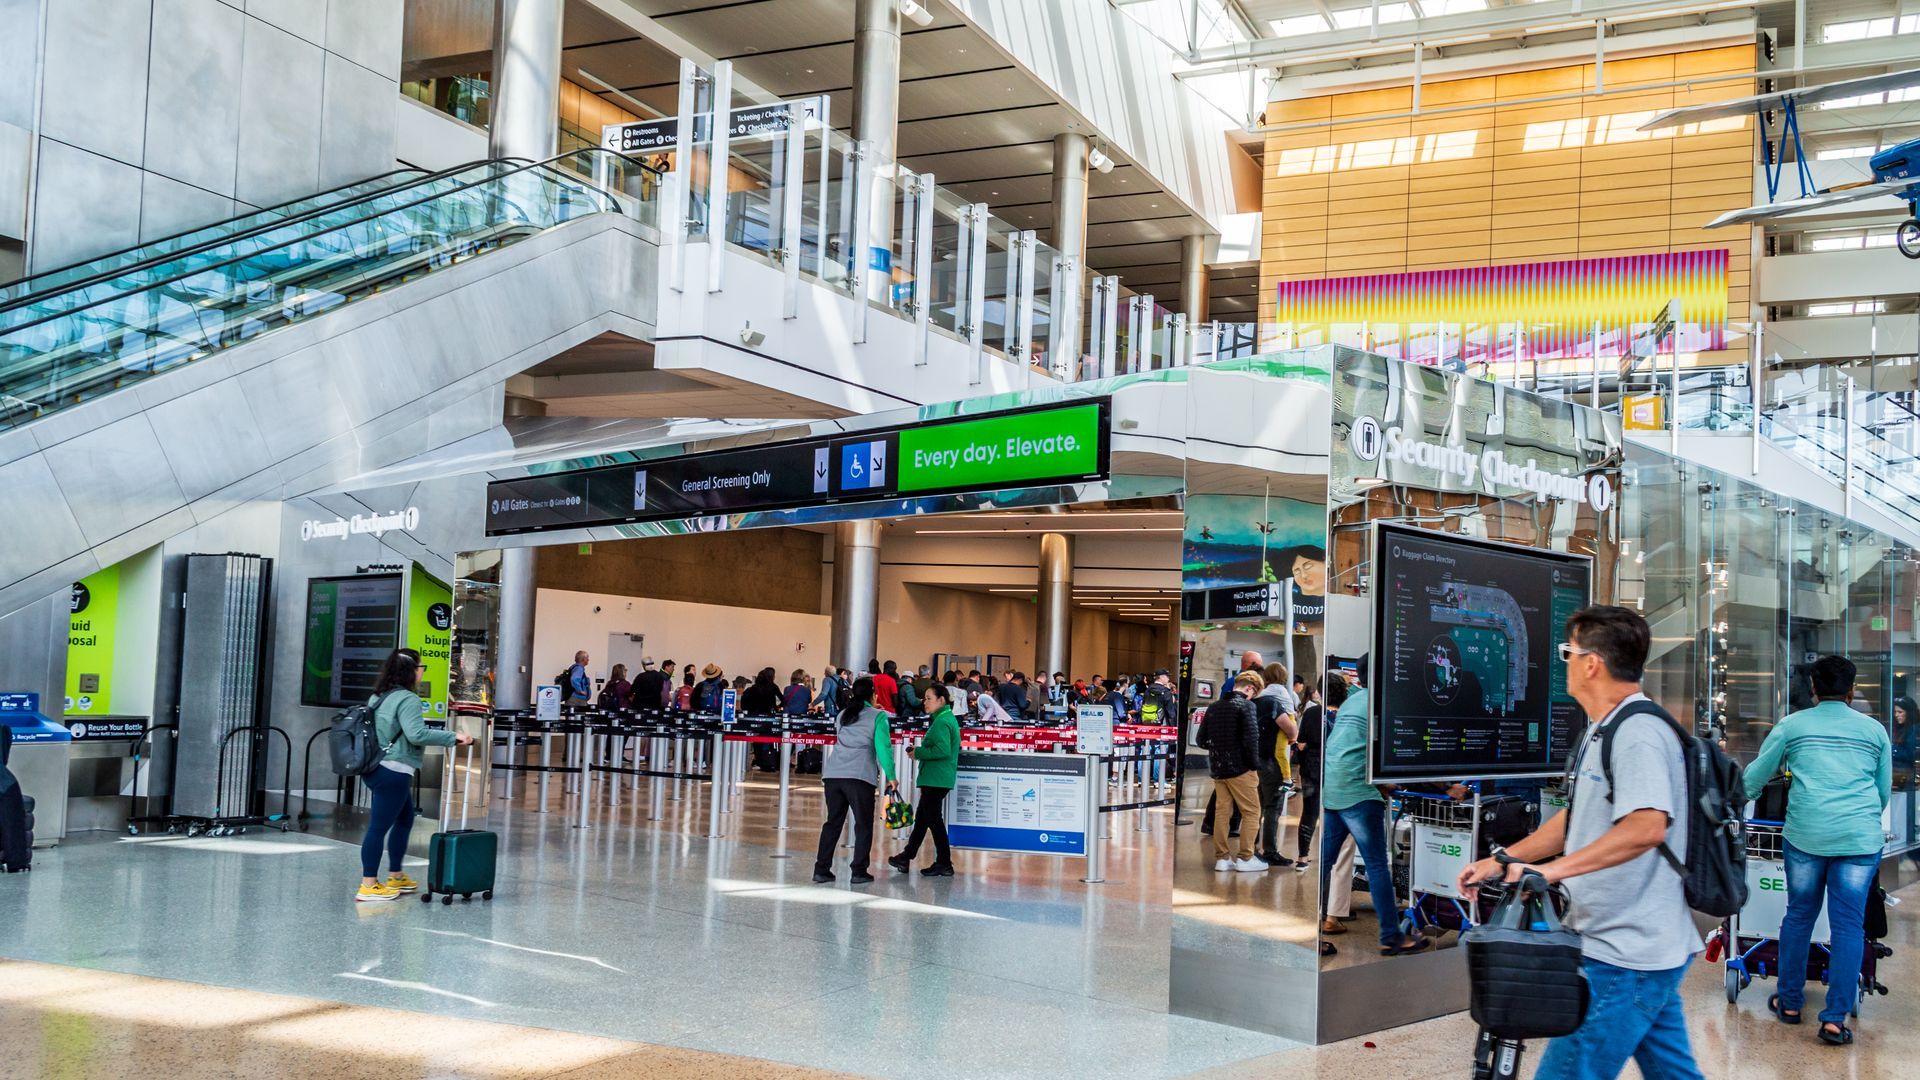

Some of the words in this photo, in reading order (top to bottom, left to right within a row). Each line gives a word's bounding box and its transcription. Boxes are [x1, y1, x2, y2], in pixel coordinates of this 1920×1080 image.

[737, 112, 761, 122] Ticketing
[632, 127, 659, 137] Restrooms
[748, 121, 778, 132] Checkpoint
[631, 139, 640, 147] All
[639, 138, 655, 146] Gates
[914, 444, 958, 469] Every
[963, 440, 1001, 465] day.
[1006, 431, 1081, 459] Elevate.
[1385, 426, 1478, 487] Security
[1481, 450, 1588, 503] Checkpoint
[682, 475, 711, 493] General
[712, 473, 751, 490] Screening
[752, 471, 771, 488] Only
[500, 500, 510, 512] All
[510, 499, 529, 511] Gates
[312, 517, 350, 541] Security
[350, 510, 406, 537] Checkpoint
[1402, 549, 1422, 561] Baggage
[1422, 552, 1435, 562] Claim
[1436, 554, 1457, 567] Directory
[71, 620, 91, 632] uid
[88, 723, 108, 731] Reuse
[109, 723, 124, 731] Your
[124, 723, 143, 731] Bottle
[1760, 877, 1788, 892] SE
